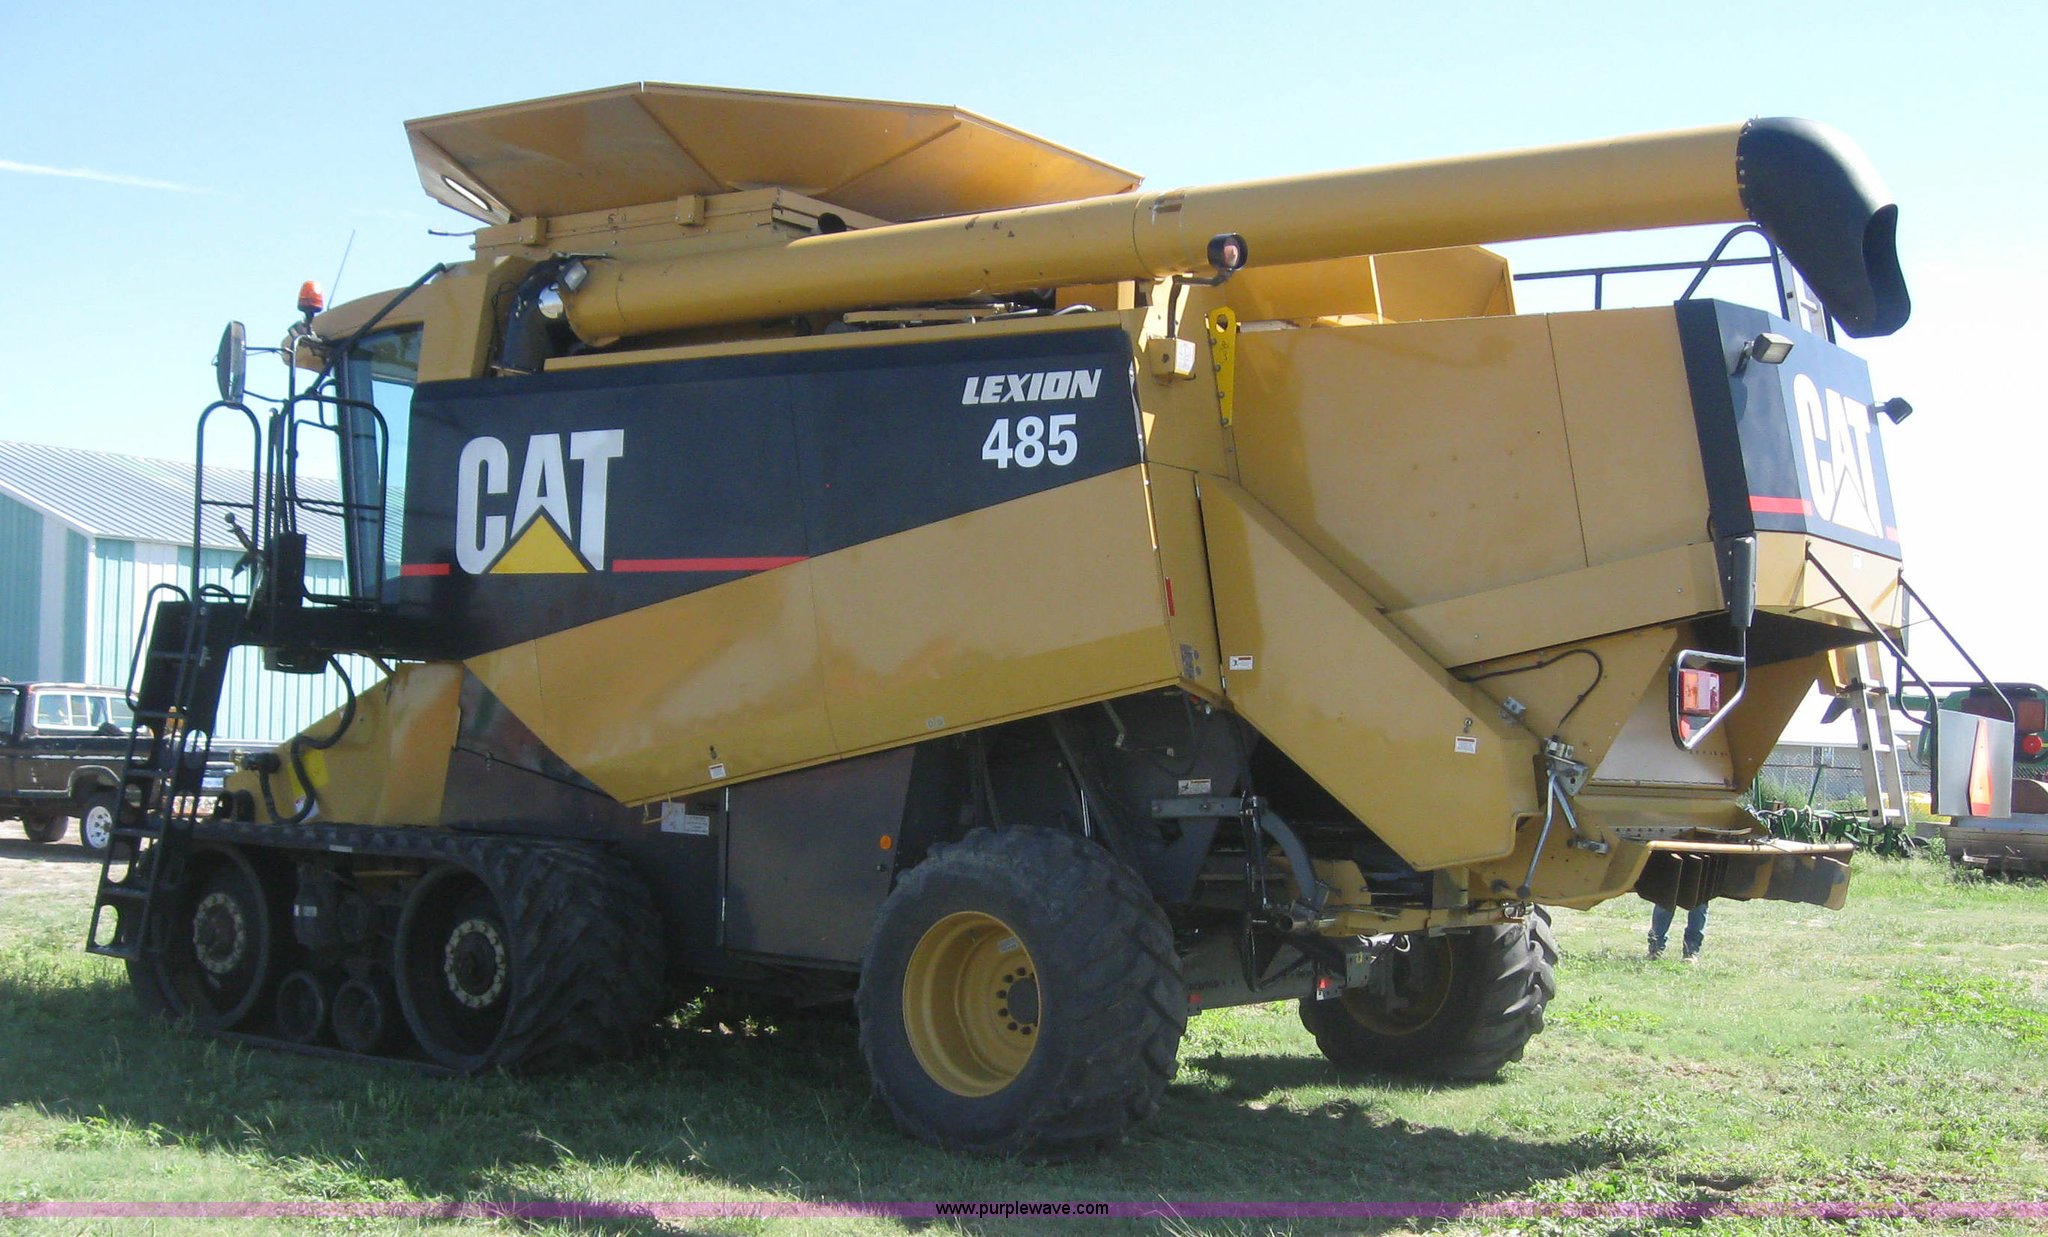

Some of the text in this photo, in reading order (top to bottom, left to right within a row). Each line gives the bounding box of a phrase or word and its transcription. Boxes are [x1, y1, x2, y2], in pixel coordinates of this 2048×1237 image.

[962, 369, 1102, 405] LEXION
[982, 413, 1078, 469] 485
[1793, 373, 1884, 539] CAT
[456, 429, 625, 575] CAT
